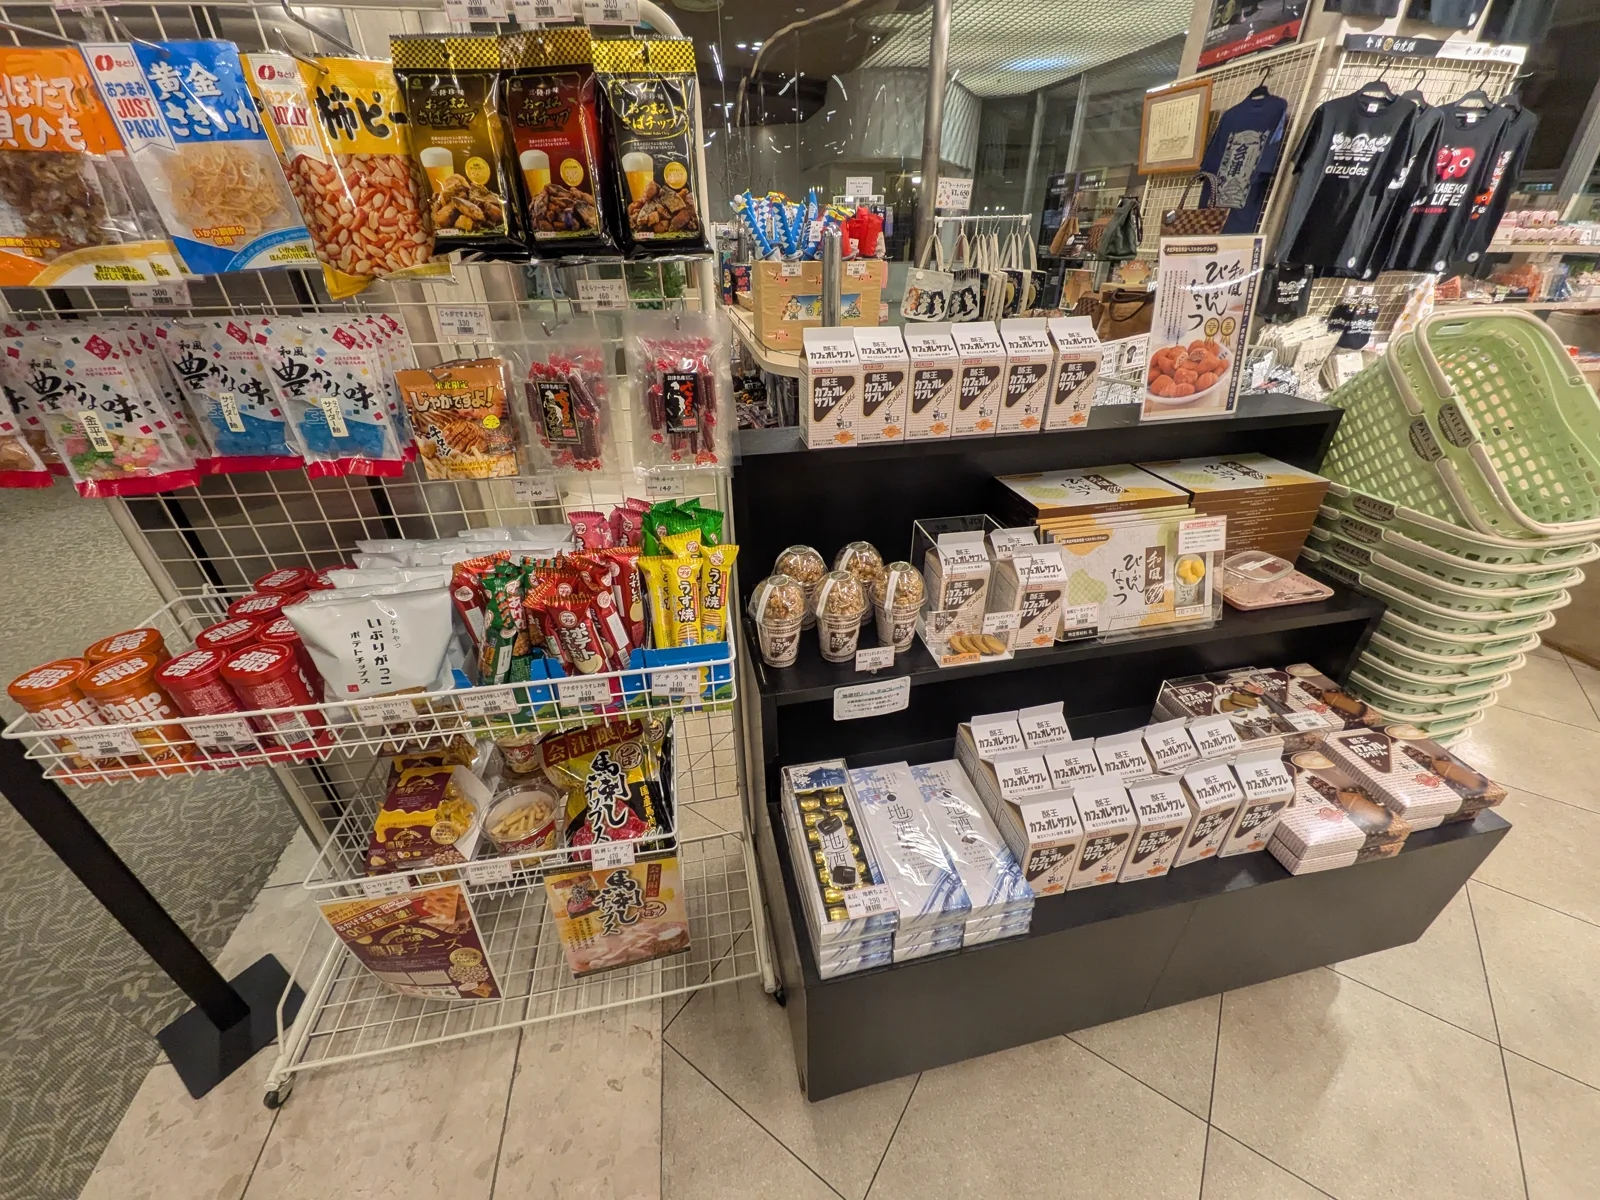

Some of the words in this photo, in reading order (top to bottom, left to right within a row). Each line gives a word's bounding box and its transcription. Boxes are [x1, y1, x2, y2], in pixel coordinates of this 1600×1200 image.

[115, 59, 134, 68] なとり
[148, 61, 223, 100] 黄金
[277, 71, 295, 79] なとり
[0, 72, 79, 111] ほたて
[104, 81, 146, 97] おつまみ
[117, 98, 155, 118] JUST
[425, 97, 469, 109] おつまみ
[523, 96, 562, 109] おつまみ
[628, 102, 669, 114] おつまみ
[165, 99, 261, 137] さきいか
[273, 106, 308, 126] JOLLY
[313, 84, 408, 141] 柿ピー
[417, 109, 476, 125] さばチップ
[517, 108, 571, 127] さばチップ
[122, 119, 166, 139] PACK
[622, 115, 678, 130] さばチップ
[1325, 162, 1368, 176] aizudes
[1227, 259, 1244, 297] 和風
[152, 288, 168, 297] 300
[179, 340, 207, 353] 和風
[278, 345, 307, 359] 和風
[860, 346, 903, 355] カフェオレサブレ
[911, 344, 954, 353] カフェオレサブレ
[960, 341, 1001, 349] カフェオレサブレ
[1008, 341, 1048, 349] カフェオレサブレ
[810, 351, 855, 359] カフェオレサブレ
[30, 358, 56, 372] 和風
[865, 382, 896, 392] カフェオレ
[915, 380, 944, 389] カフェオレ
[963, 377, 991, 387] カフェオレ
[1010, 375, 1038, 384] カフェオレ
[1059, 381, 1077, 391] サブレ
[814, 387, 846, 397] カフェオレ
[914, 389, 934, 399] サブレ
[962, 387, 981, 396] サブレ
[1008, 384, 1027, 394] サブレ
[409, 386, 494, 412] じゃがですよ!
[814, 397, 835, 407] サブレ
[864, 392, 885, 402] サブレ
[83, 415, 110, 448] 金平糖
[429, 425, 451, 456] 牛タン
[1355, 498, 1393, 517] PALETTE
[1147, 551, 1163, 580] 和風
[1123, 554, 1145, 593] ぴーかん
[705, 569, 720, 609] うす焼
[1110, 569, 1128, 606] なっつ
[678, 581, 695, 622] うす焼
[560, 627, 582, 662] うすしお
[570, 622, 595, 660] ポテト
[349, 631, 371, 684] ポテトチップス
[366, 618, 392, 686] いぶりがっこ
[978, 735, 1020, 748] カフェオレサブレ
[1027, 727, 1067, 741] カフェオレサブレ
[547, 724, 639, 762] 会津限定
[1200, 734, 1237, 750] カフェオレサブレ
[1156, 743, 1192, 759] カフェオレサブレ
[1105, 757, 1147, 772] カフェオレサブレ
[591, 750, 630, 826] 馬刺し
[1002, 773, 1047, 788] カフェオレサブレ
[585, 775, 611, 844] チップス
[1029, 817, 1077, 833] カフェオレサブレ
[1197, 817, 1224, 830] カフェオレ
[1086, 842, 1117, 854] カフェオレ
[1140, 835, 1171, 847] カフェオレ
[821, 831, 853, 869] 地酒
[1031, 853, 1064, 865] カフェオレ
[604, 869, 644, 925] 馬刺し
[861, 897, 881, 907] 1,290
[592, 888, 620, 936] チップス
[336, 909, 383, 931] おかげさまで
[366, 937, 462, 956] 濃厚チーズ
